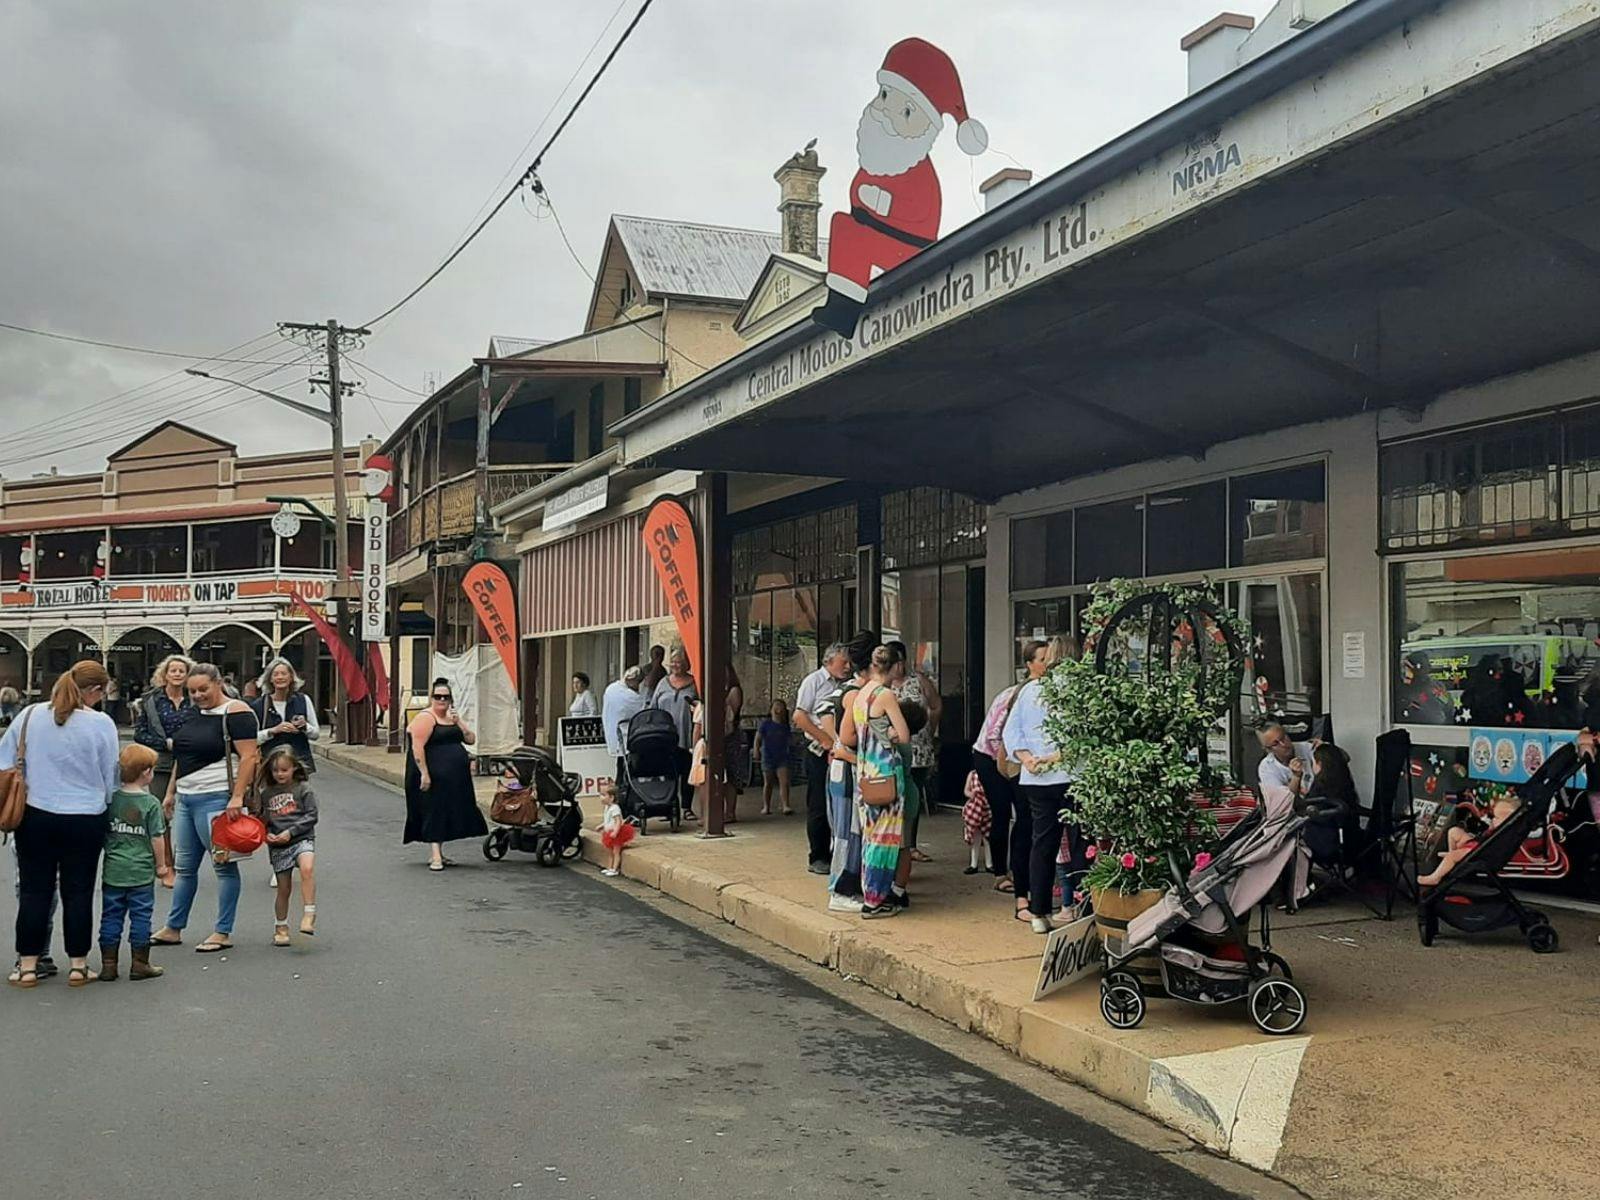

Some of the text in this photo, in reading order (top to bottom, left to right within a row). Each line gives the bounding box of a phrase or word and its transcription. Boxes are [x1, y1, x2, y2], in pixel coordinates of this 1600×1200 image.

[1172, 142, 1242, 196] NRMA
[746, 201, 1098, 402] Central Motors Canowindra Pty. Ltd.
[145, 581, 236, 603] TOOHEYS ON TAP
[367, 515, 382, 627] OLD BOOKS
[653, 528, 694, 624] COFFEE
[472, 580, 513, 648] COFFEE
